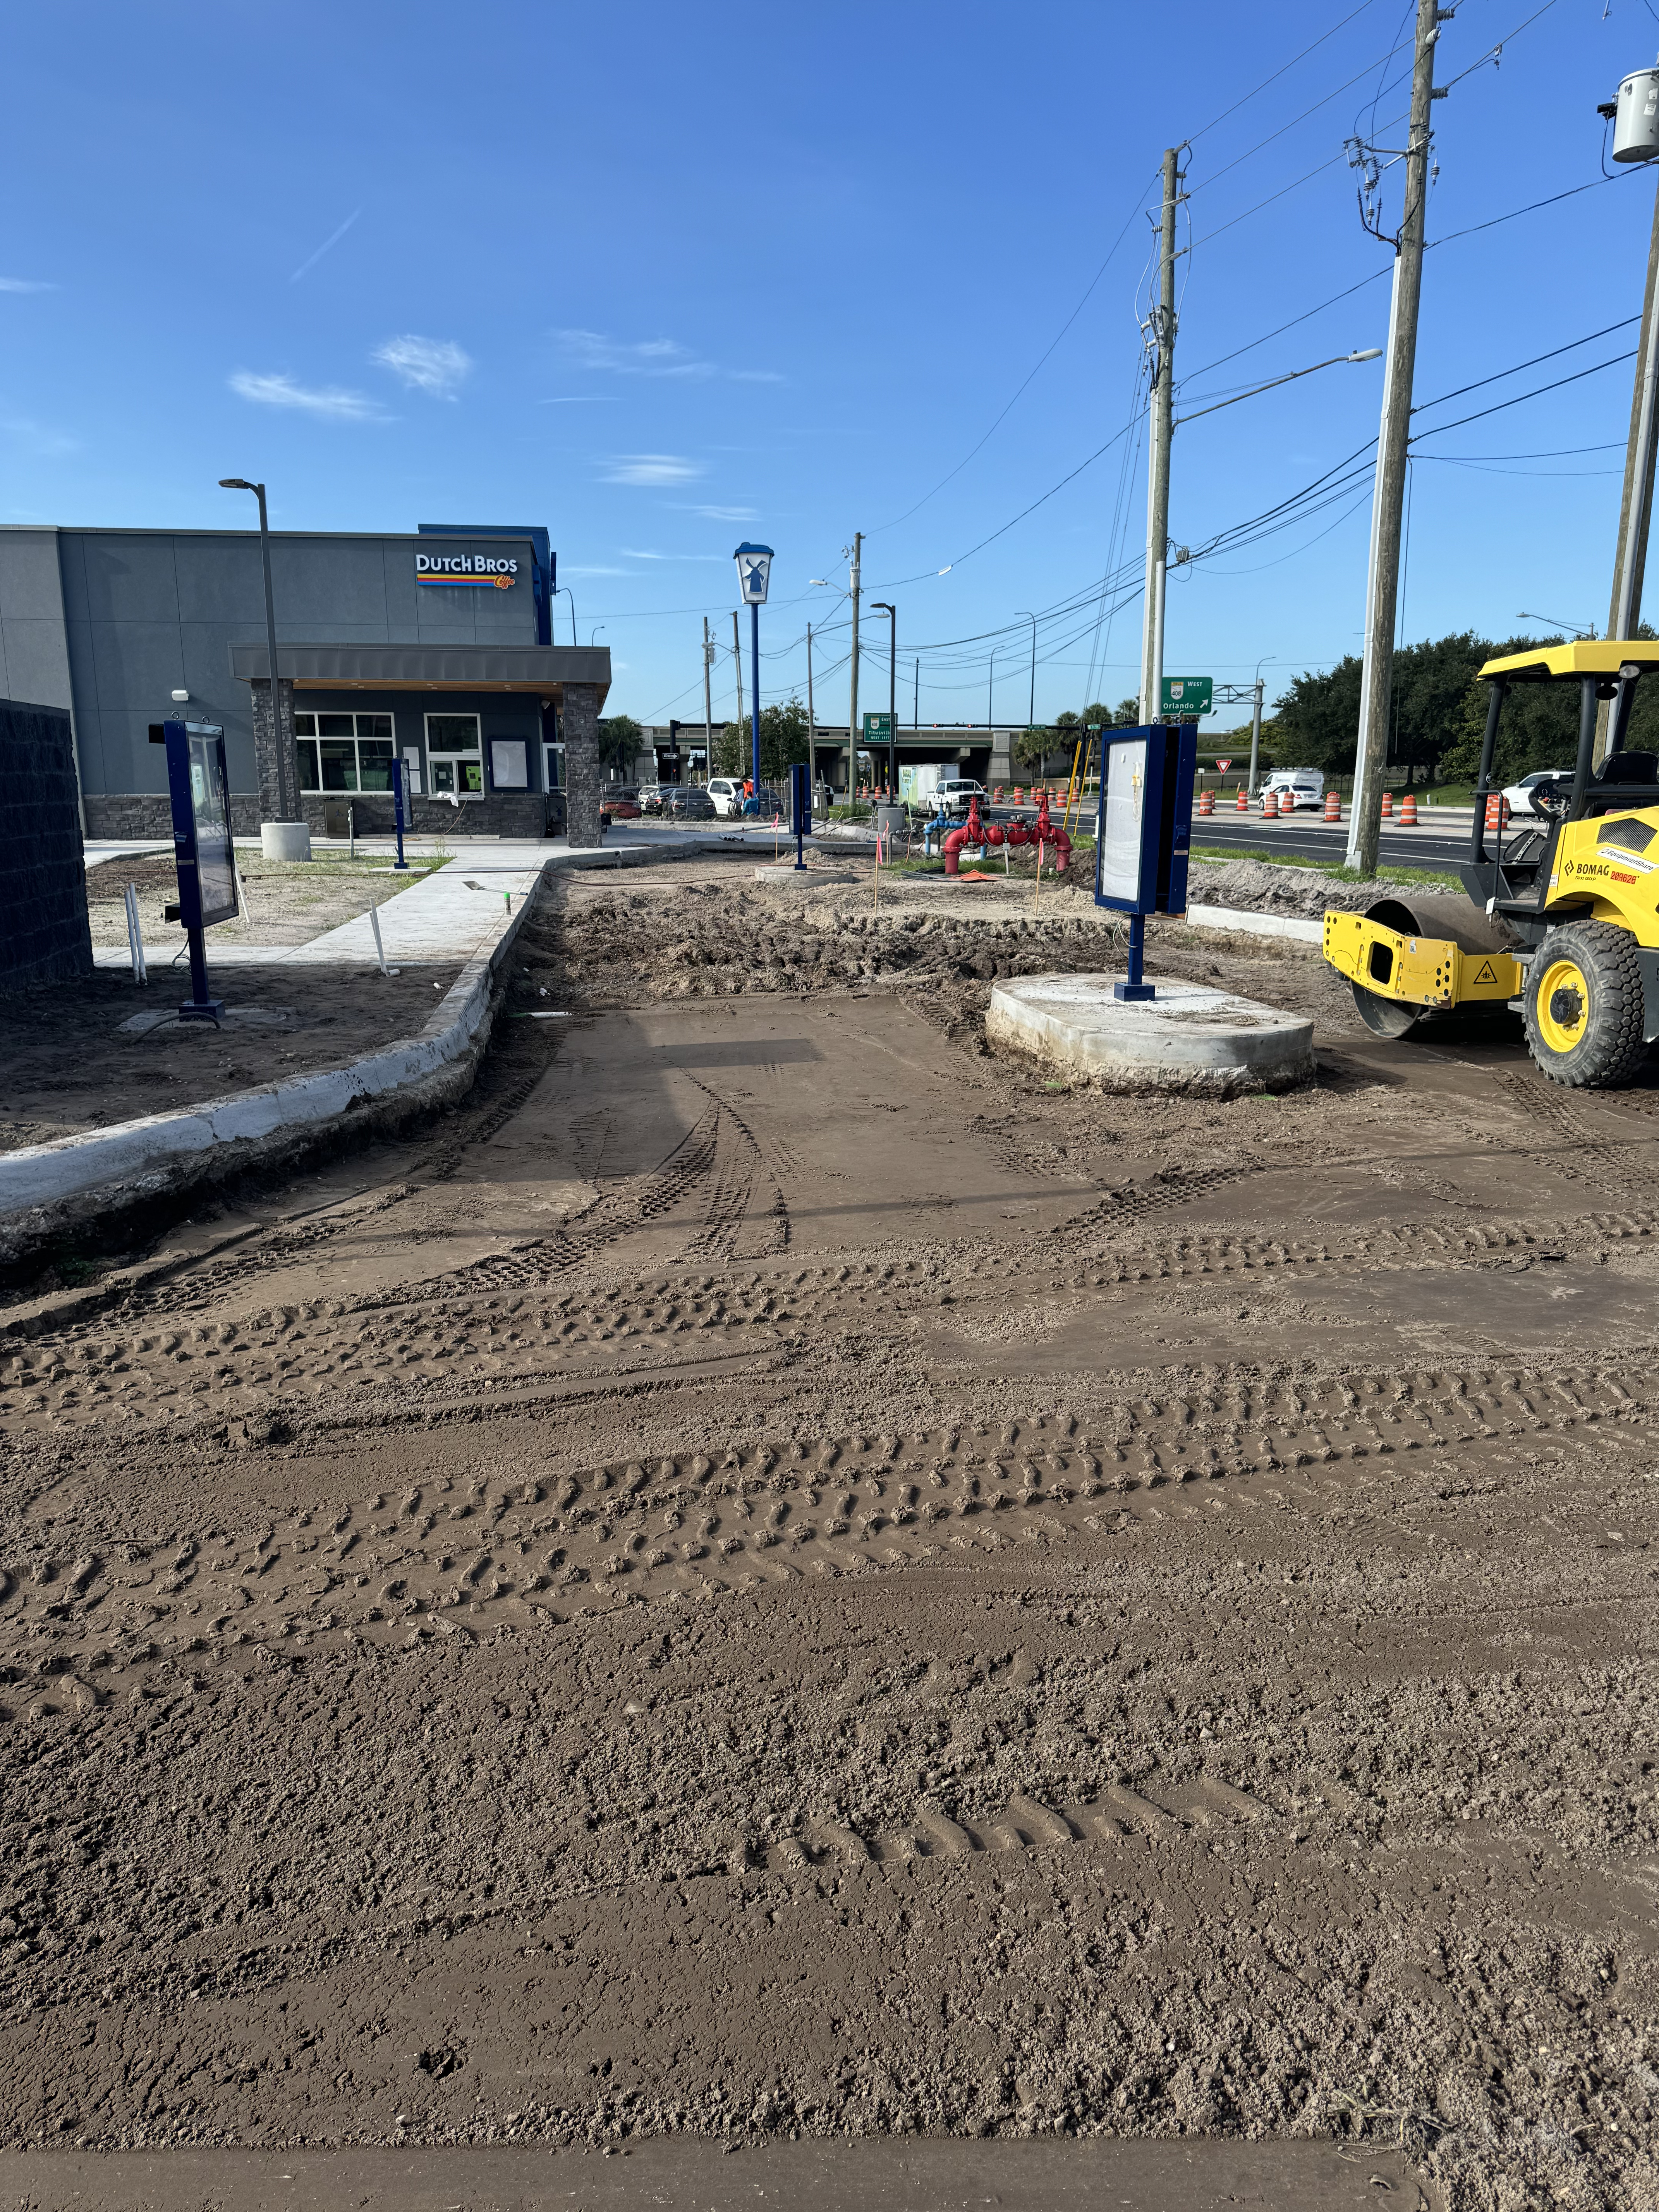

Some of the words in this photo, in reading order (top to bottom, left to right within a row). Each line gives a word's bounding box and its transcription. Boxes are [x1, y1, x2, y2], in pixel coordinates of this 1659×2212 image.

[416, 554, 472, 572] DUTCH
[474, 555, 517, 572] BROS
[494, 574, 515, 589] Coffee
[1607, 850, 1654, 871] EquipmentShare
[1577, 864, 1610, 876] BOMAG
